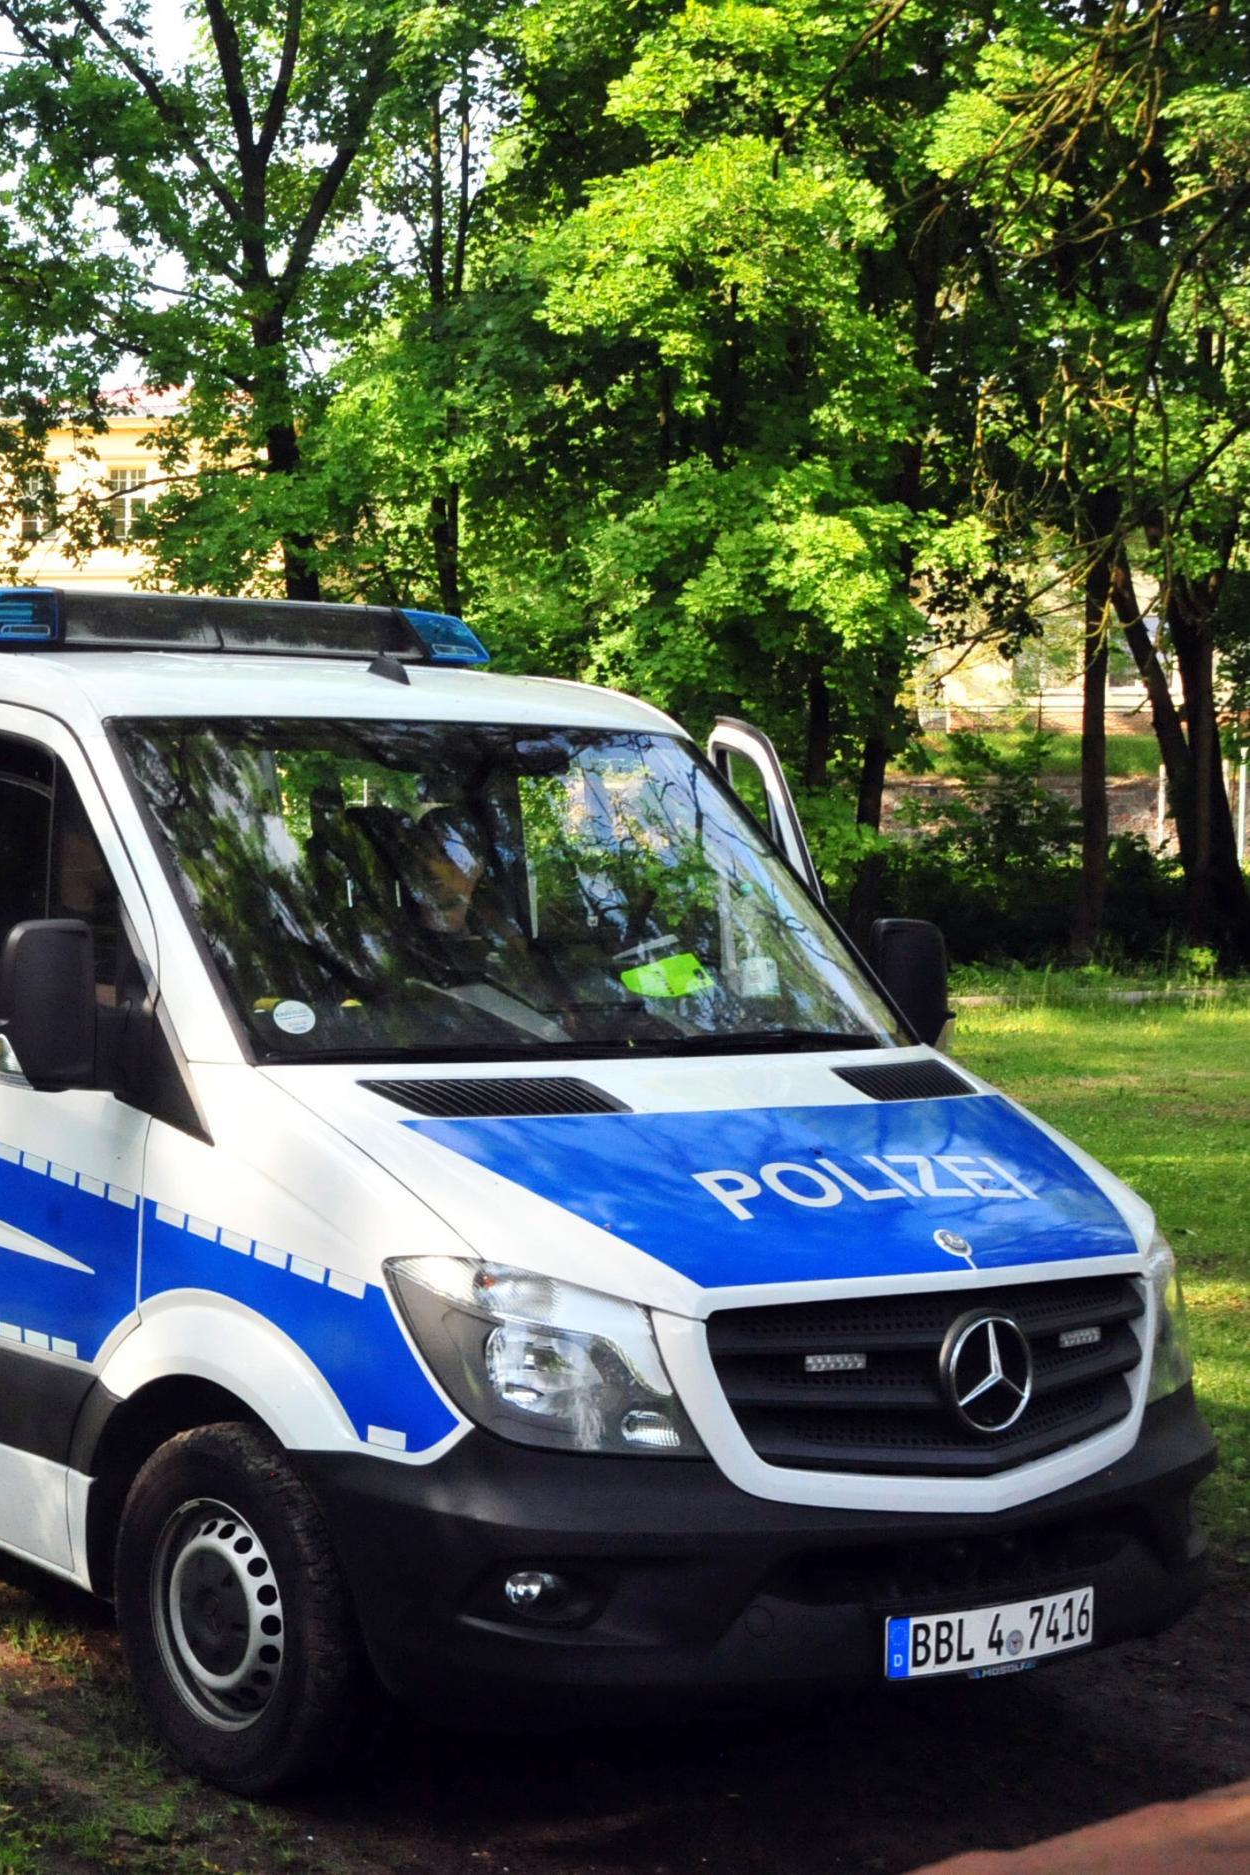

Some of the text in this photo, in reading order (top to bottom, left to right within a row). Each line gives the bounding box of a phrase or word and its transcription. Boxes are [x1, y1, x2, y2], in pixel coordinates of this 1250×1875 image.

[690, 1155, 1040, 1221] POLIZEI
[893, 1654, 903, 1667] D
[912, 1593, 1090, 1668] BBL 4 7416
